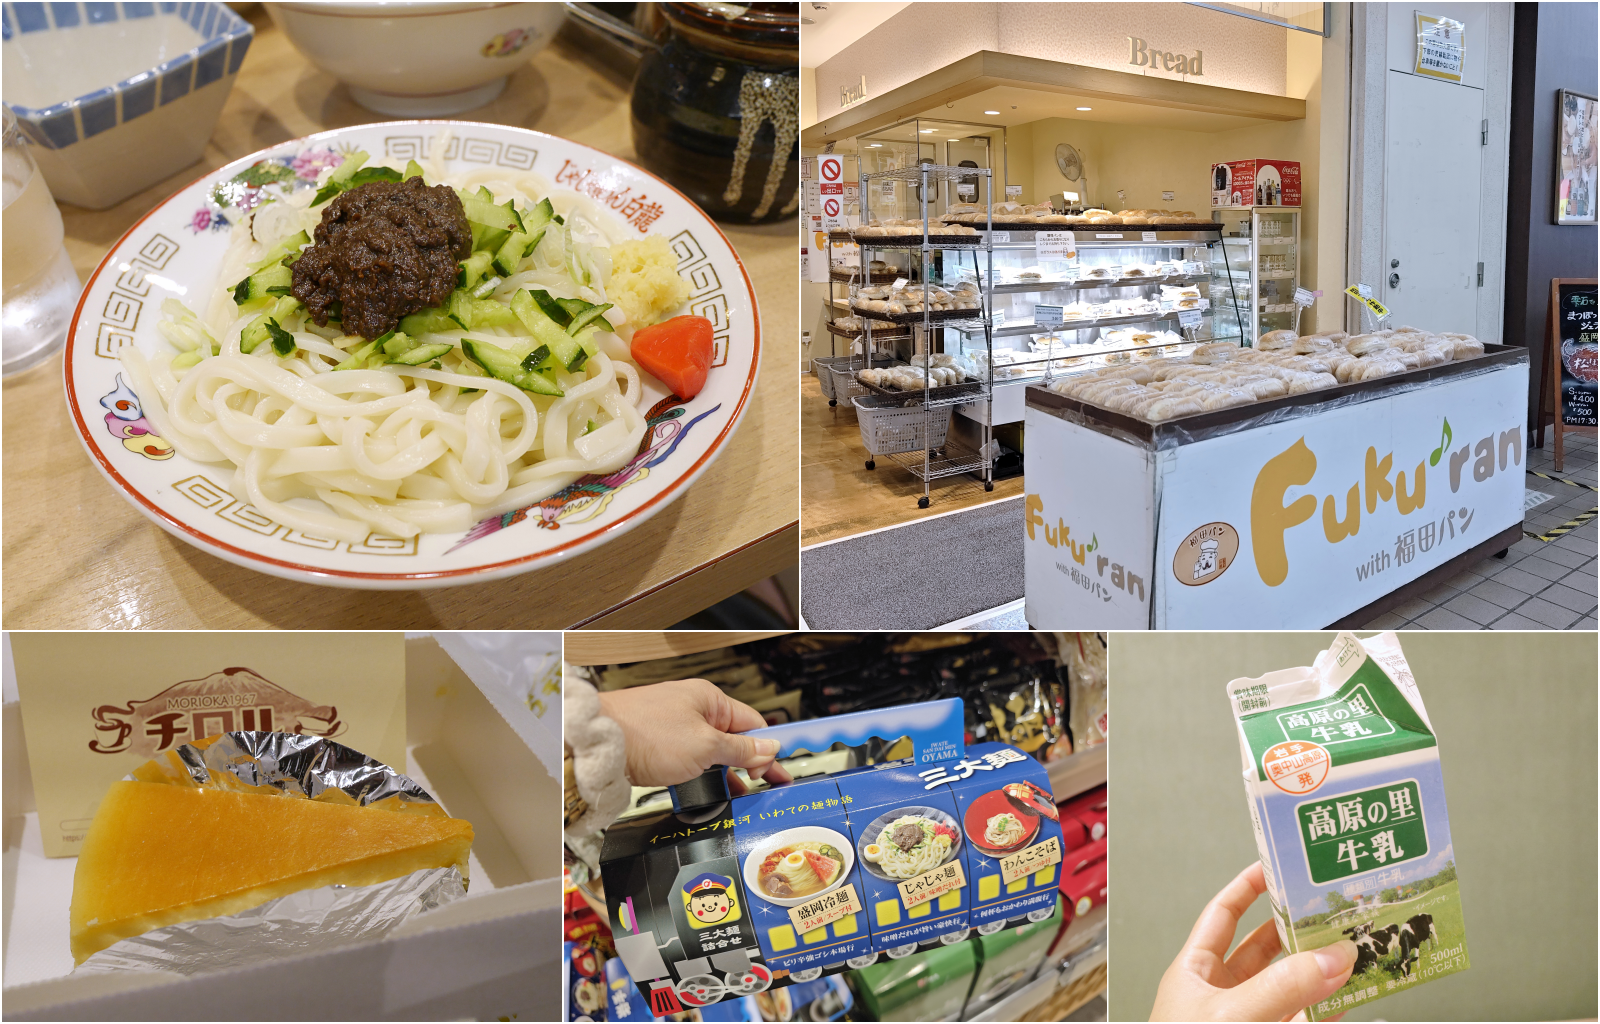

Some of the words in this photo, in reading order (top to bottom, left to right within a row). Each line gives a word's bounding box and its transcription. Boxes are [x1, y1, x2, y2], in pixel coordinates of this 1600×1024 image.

[1127, 36, 1204, 76] Bread
[840, 75, 866, 108] Bread
[1356, 549, 1391, 582] with
[1394, 506, 1475, 568] 福田パン
[1055, 561, 1070, 577] with
[1071, 567, 1112, 602] 福田パン
[1284, 693, 1373, 729] 高原の里
[1310, 720, 1373, 742] 牛乳
[921, 749, 958, 763] OYAMA
[1270, 750, 1324, 777] 奥中山高原
[1273, 743, 1304, 758] 岩手
[1297, 772, 1314, 788] 発
[1305, 787, 1417, 841] 高原の里
[1003, 840, 1058, 871] わんこそば
[1336, 829, 1405, 871] 牛乳
[904, 865, 956, 895] じゃじゃ麺
[1377, 868, 1405, 885] 牛乳
[798, 889, 850, 920] 盛岡冷麺
[701, 936, 742, 952] 詰合せ
[1430, 943, 1464, 964] 500ml
[1318, 985, 1379, 1014] 成分無調整
